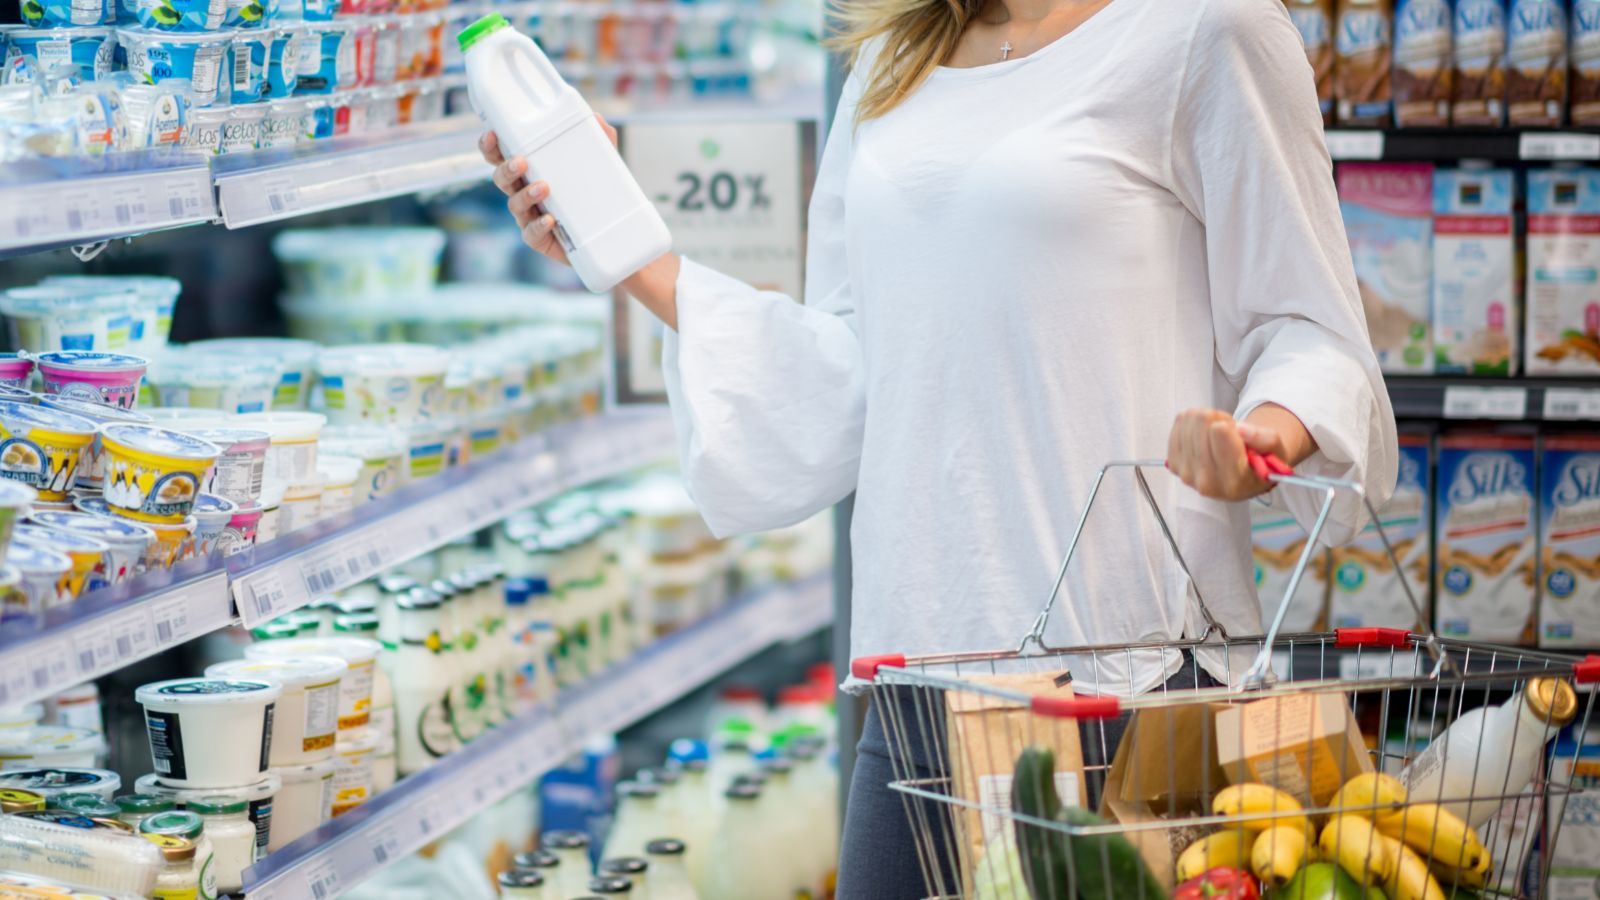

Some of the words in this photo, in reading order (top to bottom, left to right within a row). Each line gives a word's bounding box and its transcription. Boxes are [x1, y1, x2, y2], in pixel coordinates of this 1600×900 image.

[655, 171, 771, 211] -20%
[1453, 458, 1527, 500] Silk
[1557, 464, 1600, 503] Sil
